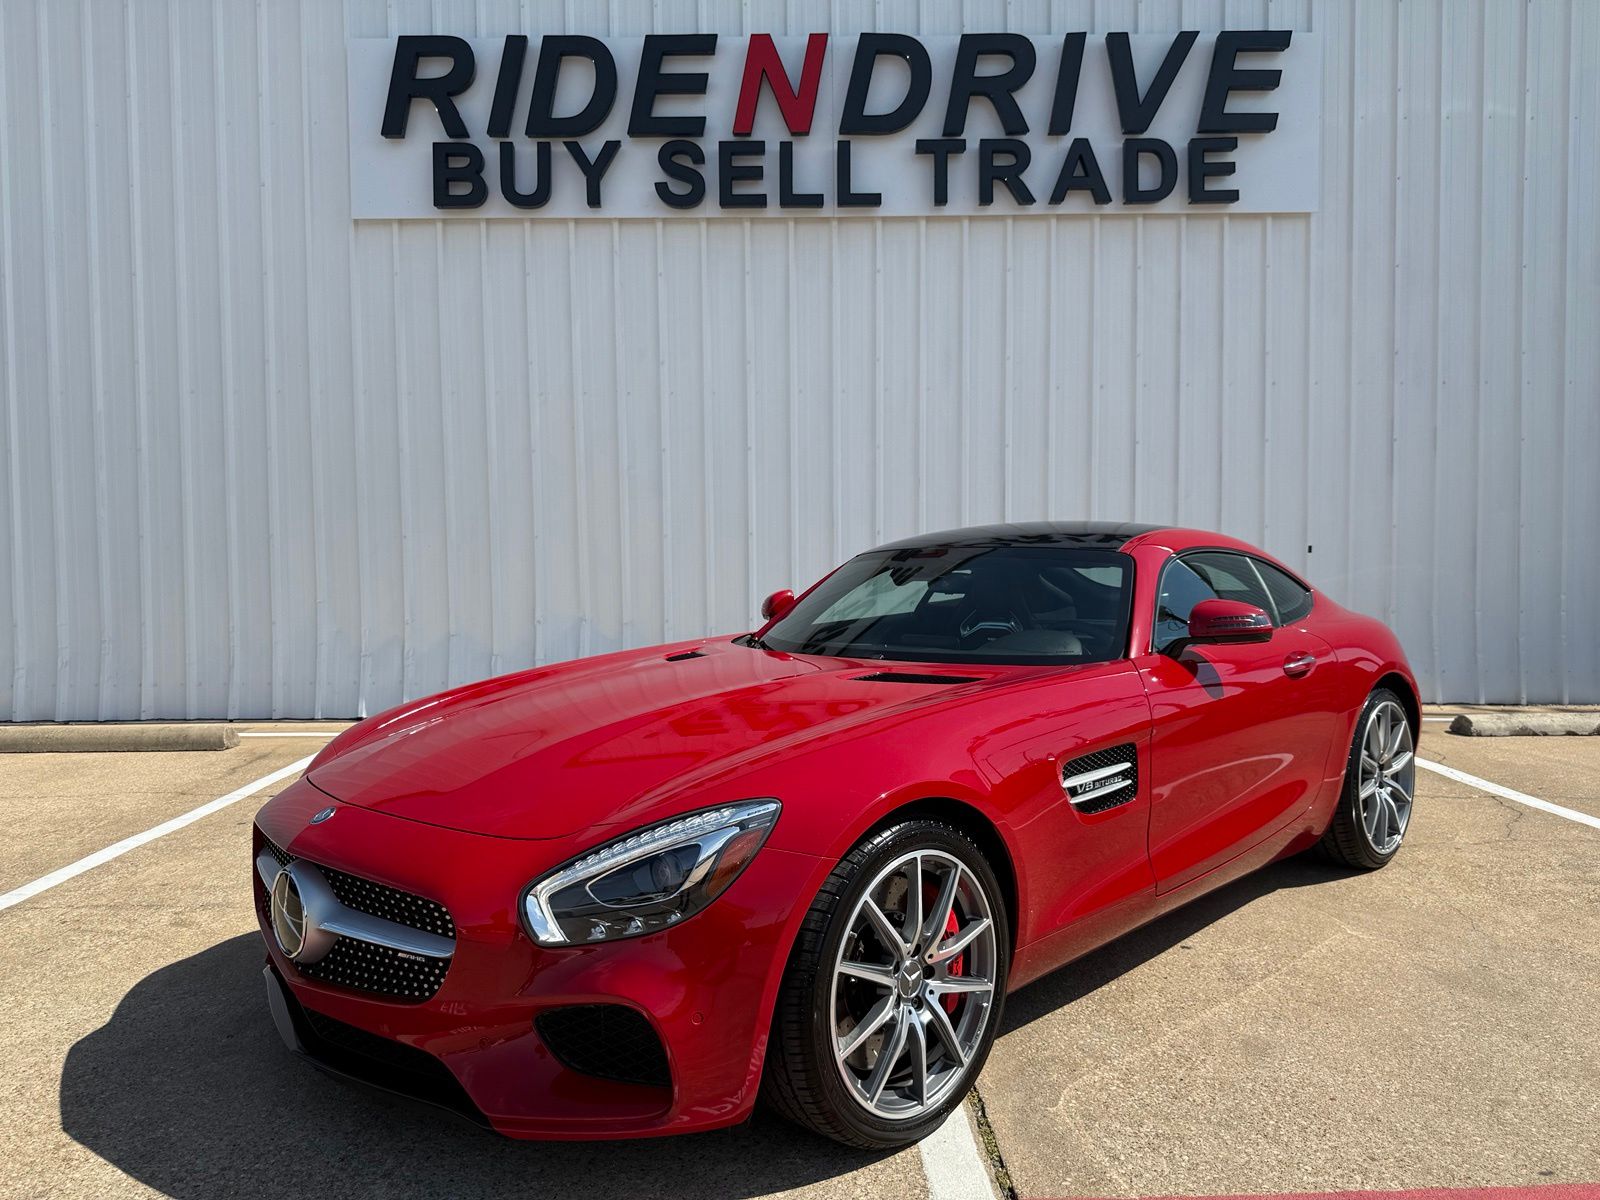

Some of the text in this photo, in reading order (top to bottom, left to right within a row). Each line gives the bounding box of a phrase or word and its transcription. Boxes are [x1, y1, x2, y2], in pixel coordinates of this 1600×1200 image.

[381, 30, 1293, 139] RIDENDRIVE
[433, 137, 1240, 210] BUY SELL TRADE
[1077, 781, 1094, 793] V8
